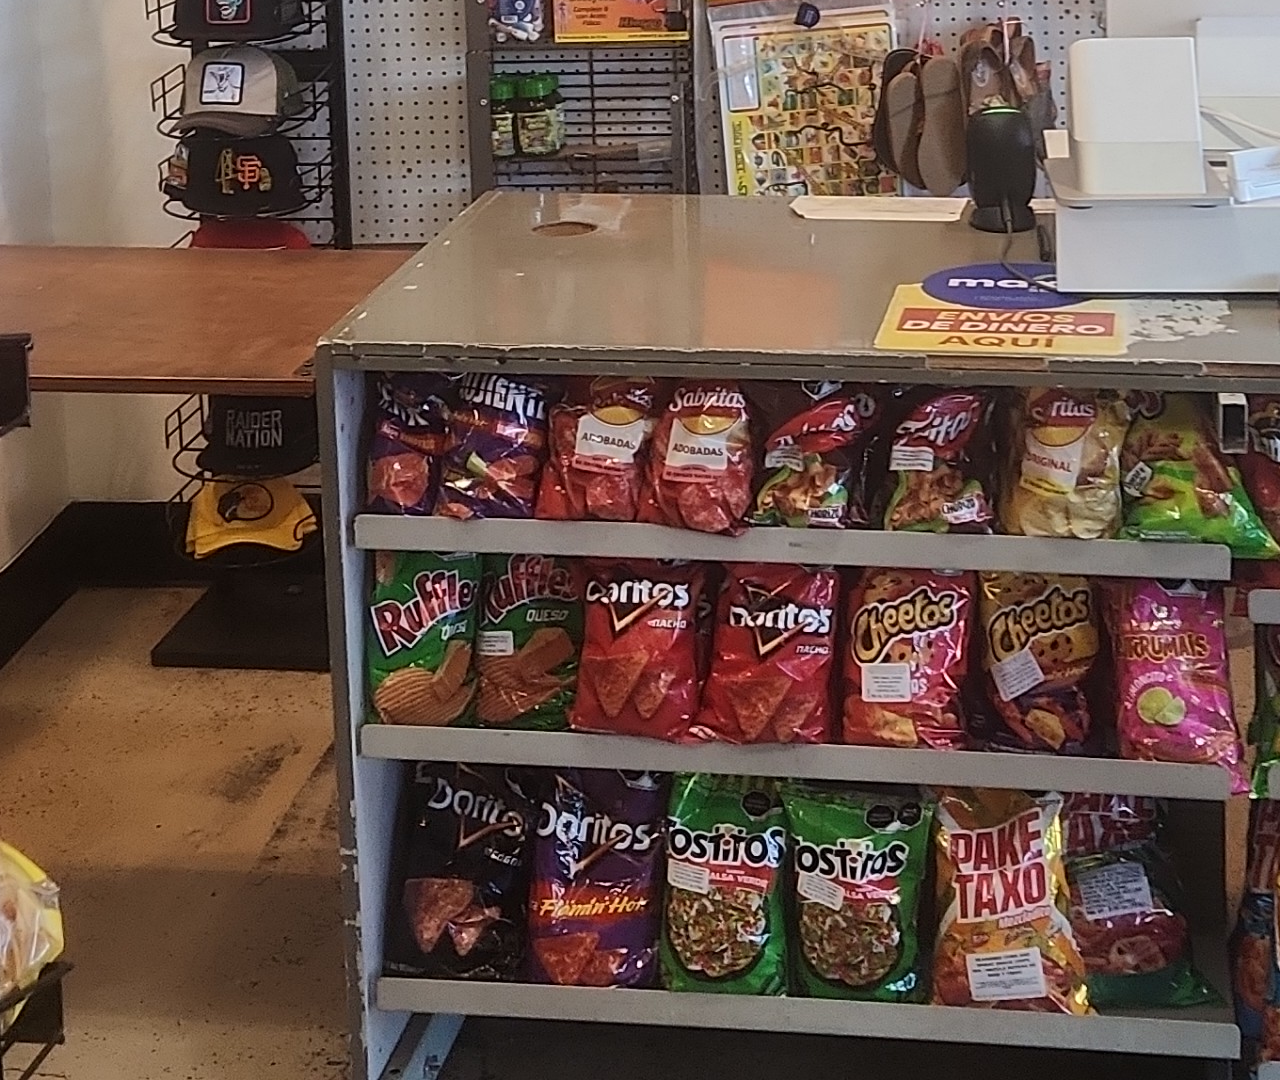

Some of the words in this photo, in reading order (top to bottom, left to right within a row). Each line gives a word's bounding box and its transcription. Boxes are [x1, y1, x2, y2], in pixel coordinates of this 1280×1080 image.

[948, 278, 1058, 289] max
[901, 320, 950, 330] DE
[965, 321, 1106, 334] DINERO
[937, 310, 1076, 323] ENVÍOS
[938, 335, 1053, 348] AQUÍ
[669, 387, 746, 411] Sabritas
[1032, 396, 1096, 420] Sritas
[227, 409, 282, 428] RAIDER
[226, 429, 283, 448] NATION
[581, 432, 636, 450] ADOBADAS
[672, 443, 724, 457] ADOBADAS
[1027, 451, 1072, 473] ORIGINAL
[587, 575, 691, 608] Doritos
[526, 609, 569, 622] QUESO
[730, 602, 833, 635] Doritos
[852, 586, 957, 666] Cheetos
[987, 585, 1091, 663] Cheetos
[427, 778, 525, 839] Dorito
[537, 802, 652, 851] Doritos
[950, 808, 1043, 872] PAKE
[955, 862, 1047, 920] TAXO
